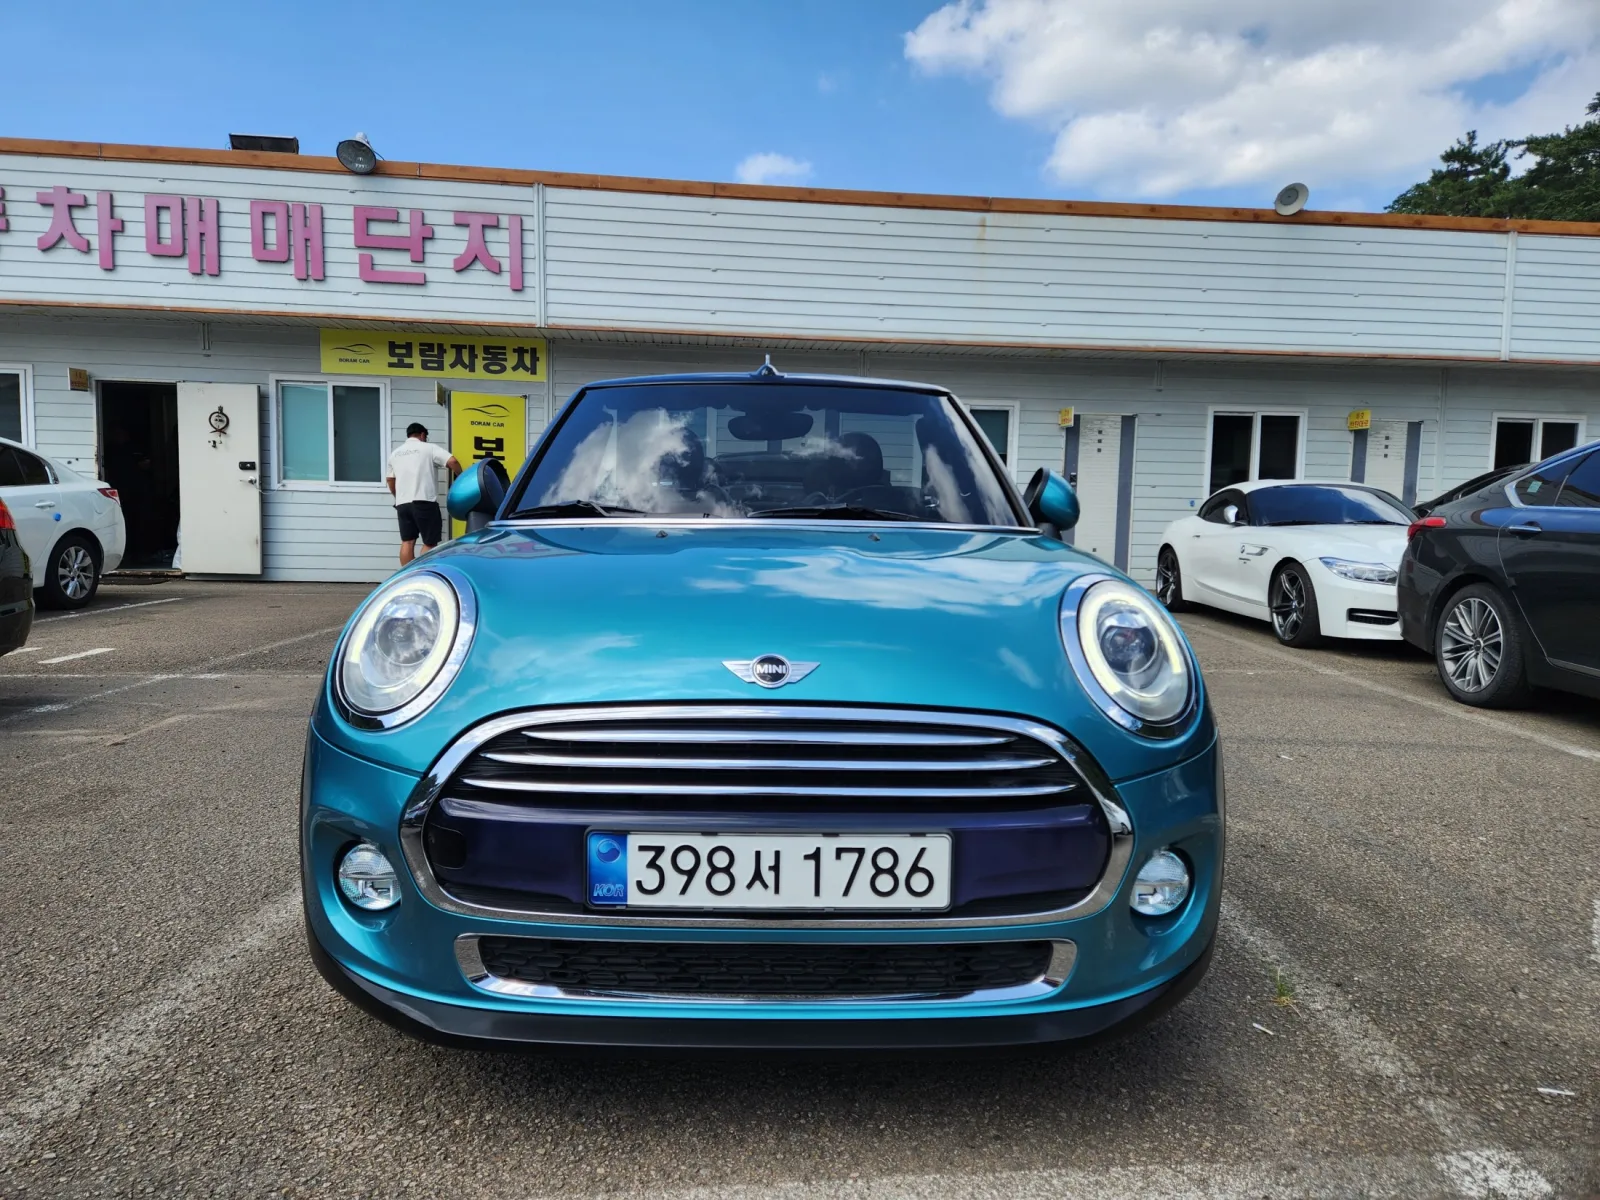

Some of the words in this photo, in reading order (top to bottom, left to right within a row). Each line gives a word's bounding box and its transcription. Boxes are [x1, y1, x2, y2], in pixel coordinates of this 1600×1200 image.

[0, 185, 524, 291] 차매매단지
[387, 340, 540, 375] 보람자동차
[756, 664, 787, 674] MINI
[635, 845, 781, 896] 398서
[803, 846, 935, 898] 1786
[593, 883, 625, 897] KOR
